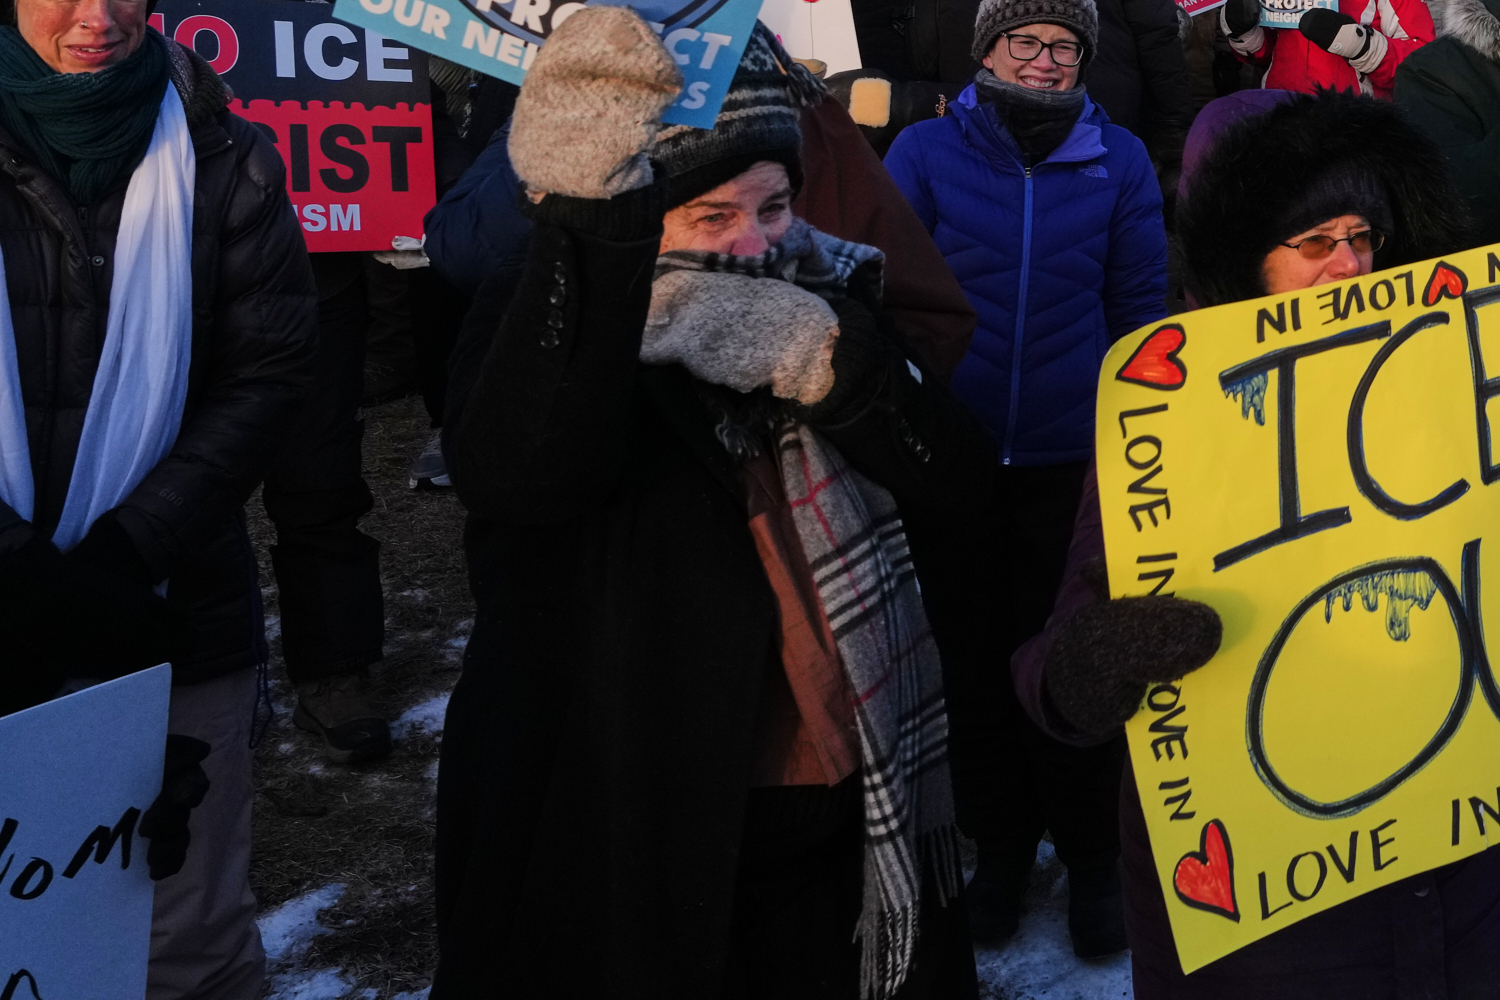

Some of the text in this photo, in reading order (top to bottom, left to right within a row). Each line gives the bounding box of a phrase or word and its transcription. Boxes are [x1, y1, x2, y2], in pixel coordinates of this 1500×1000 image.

[274, 20, 413, 83] ICE
[1256, 301, 1300, 343] IN
[1318, 270, 1414, 326] LOVE
[1118, 403, 1172, 532] LOVE
[1141, 682, 1190, 763] OVE
[1158, 777, 1197, 822] IN
[1258, 819, 1399, 922] LOVE
